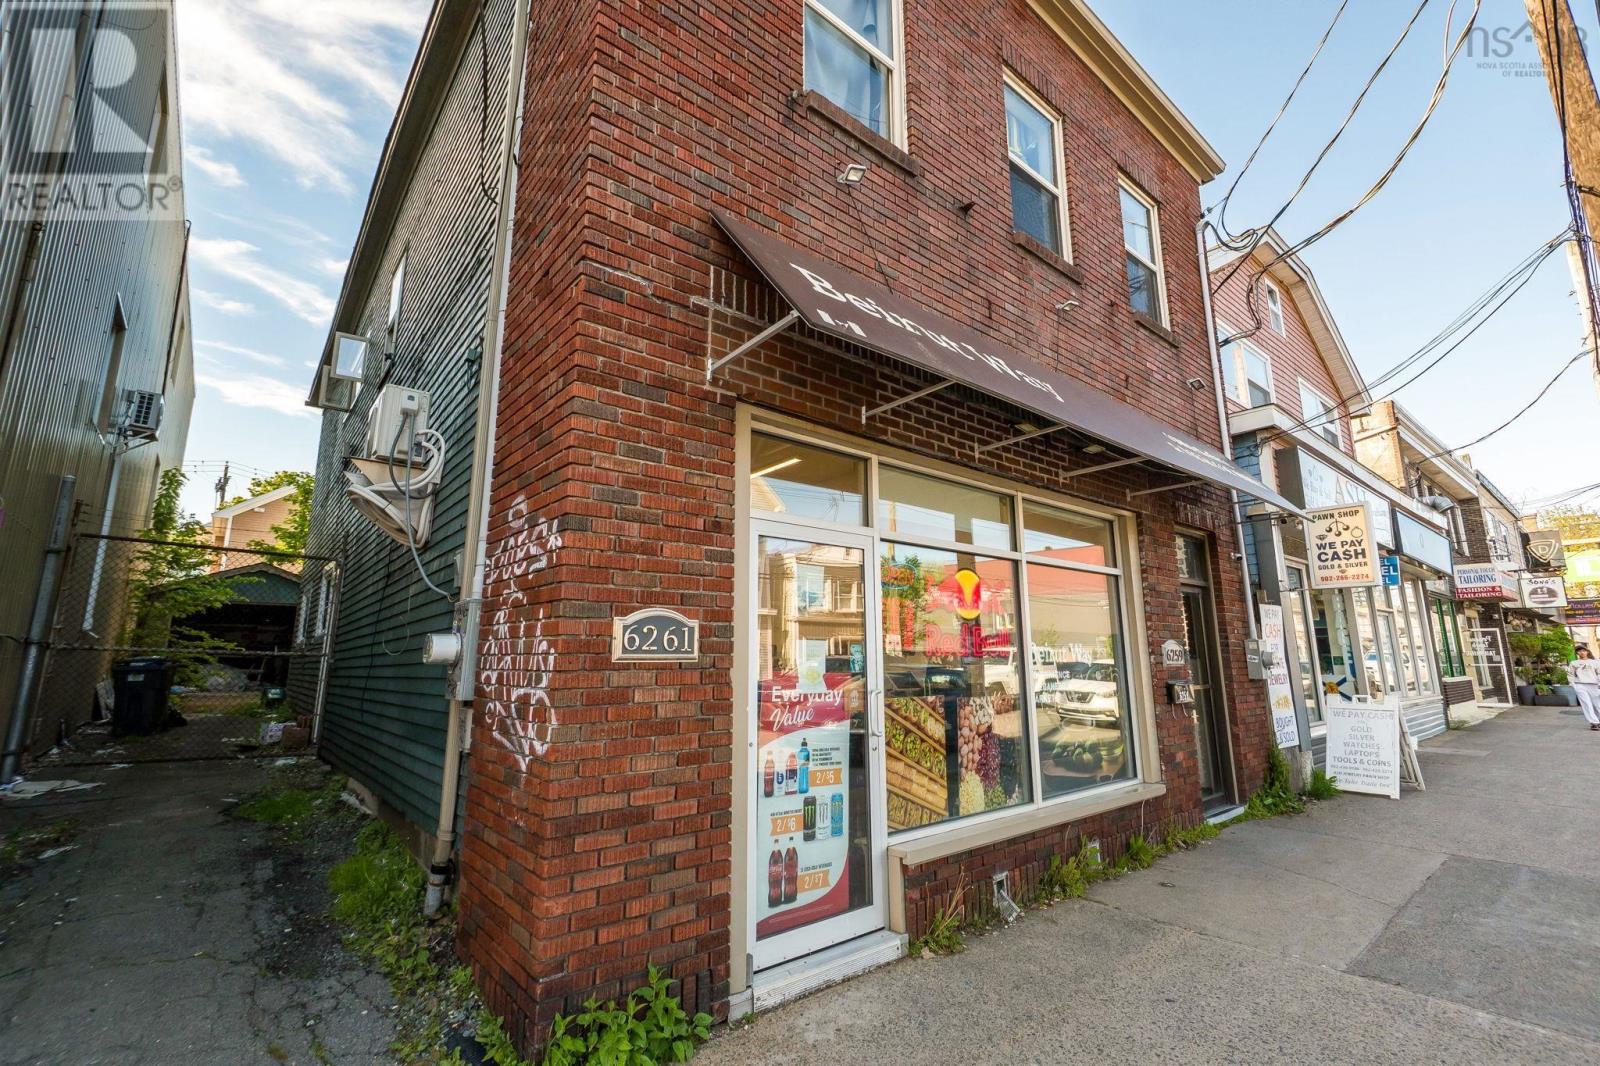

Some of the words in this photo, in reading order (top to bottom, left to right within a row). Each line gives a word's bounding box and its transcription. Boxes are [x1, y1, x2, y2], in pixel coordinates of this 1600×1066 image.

[789, 262, 975, 361] Beirut
[961, 342, 1065, 403] Way
[1312, 512, 1336, 521] PAWN
[1338, 509, 1360, 519] SHOP
[1317, 543, 1337, 551] WE
[1341, 539, 1364, 548] PAY
[1345, 561, 1369, 569] SILVER
[1458, 574, 1497, 585] TAILORING
[1265, 623, 1281, 639] CASH
[624, 625, 692, 651] 6261
[925, 624, 968, 656] Red
[1166, 648, 1183, 662] 6259
[772, 685, 844, 706] Everyday
[770, 705, 815, 731] Value
[1348, 711, 1366, 719] PAY
[1343, 742, 1381, 750] WATCHES
[1344, 750, 1381, 758] LAPTOPS
[1367, 759, 1392, 767] COINS
[804, 874, 823, 888] 2/$7
